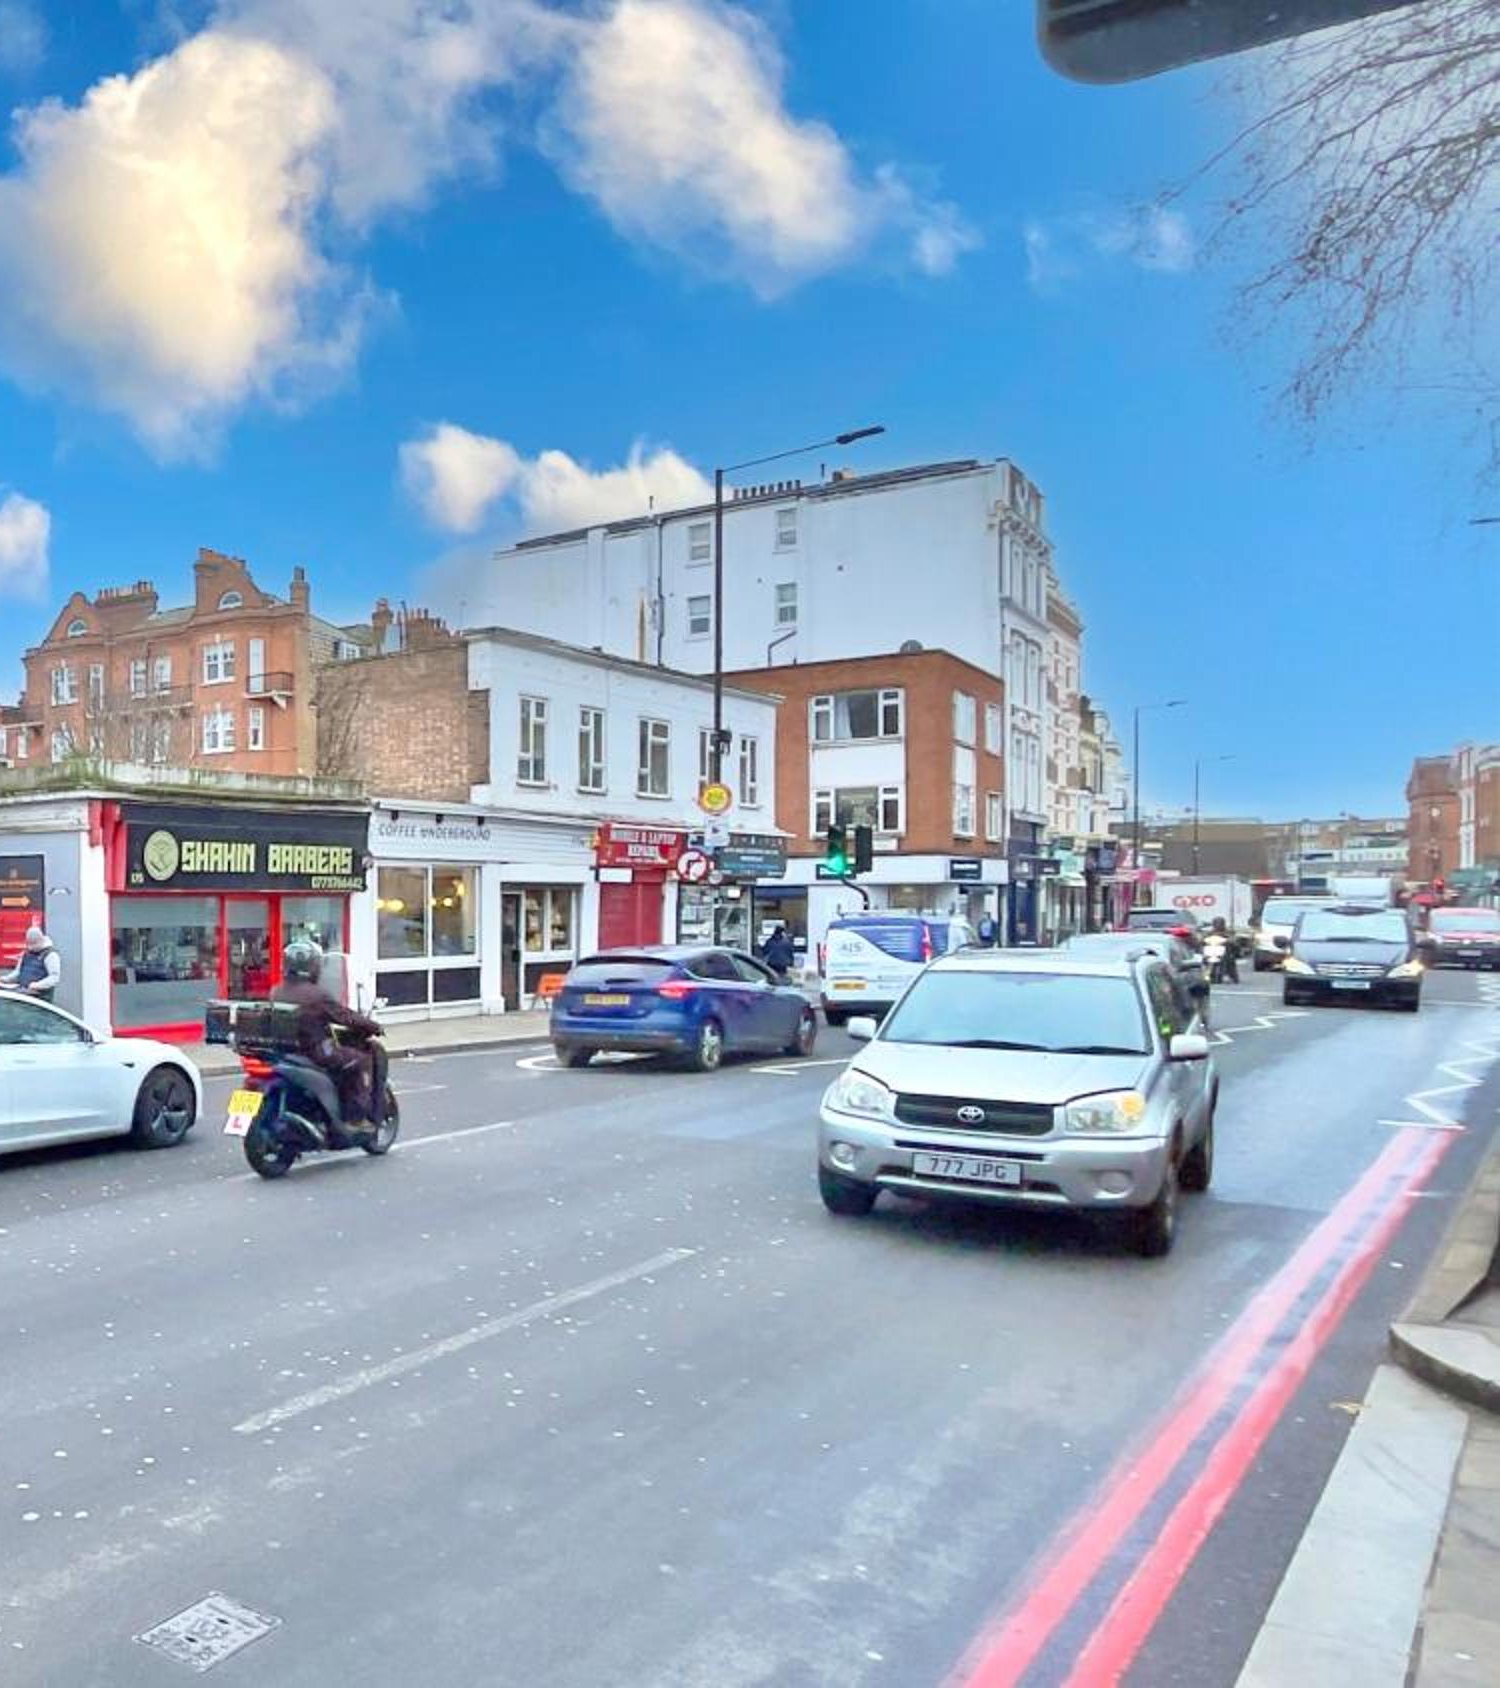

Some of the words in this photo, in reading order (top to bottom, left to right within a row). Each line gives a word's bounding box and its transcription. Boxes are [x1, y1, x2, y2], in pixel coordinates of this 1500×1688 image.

[378, 823, 416, 838] COFFEE
[181, 841, 256, 873] SHAHIN
[267, 844, 353, 875] BARBERS
[1172, 895, 1216, 908] GXO
[232, 1116, 243, 1129] L
[930, 1157, 964, 1174] 777
[970, 1163, 1007, 1180] JPG
